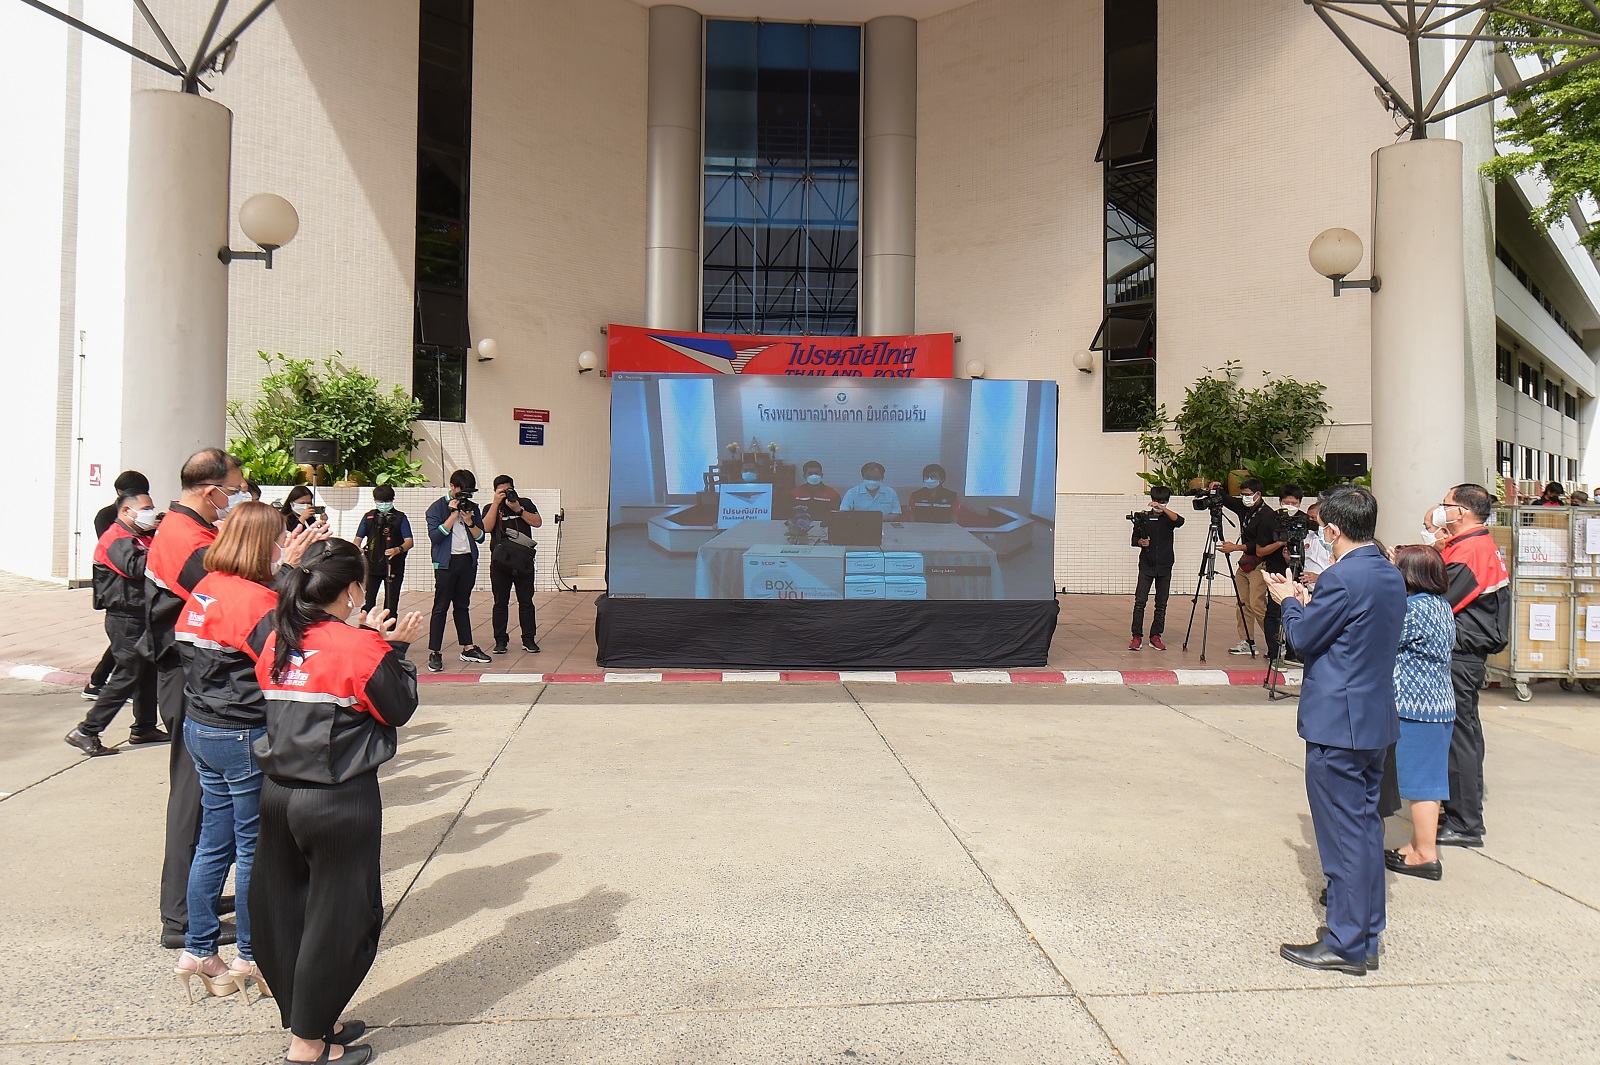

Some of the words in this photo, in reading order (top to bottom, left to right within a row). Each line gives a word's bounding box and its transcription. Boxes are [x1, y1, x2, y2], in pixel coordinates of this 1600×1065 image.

[784, 341, 917, 366] ไปรษณีย์ไทย
[757, 404, 863, 422] โรงพยาบาลบ้านตาก
[866, 404, 927, 422] ยินดีต้อนรับ
[1524, 546, 1542, 554] BOX
[765, 580, 794, 590] BOX
